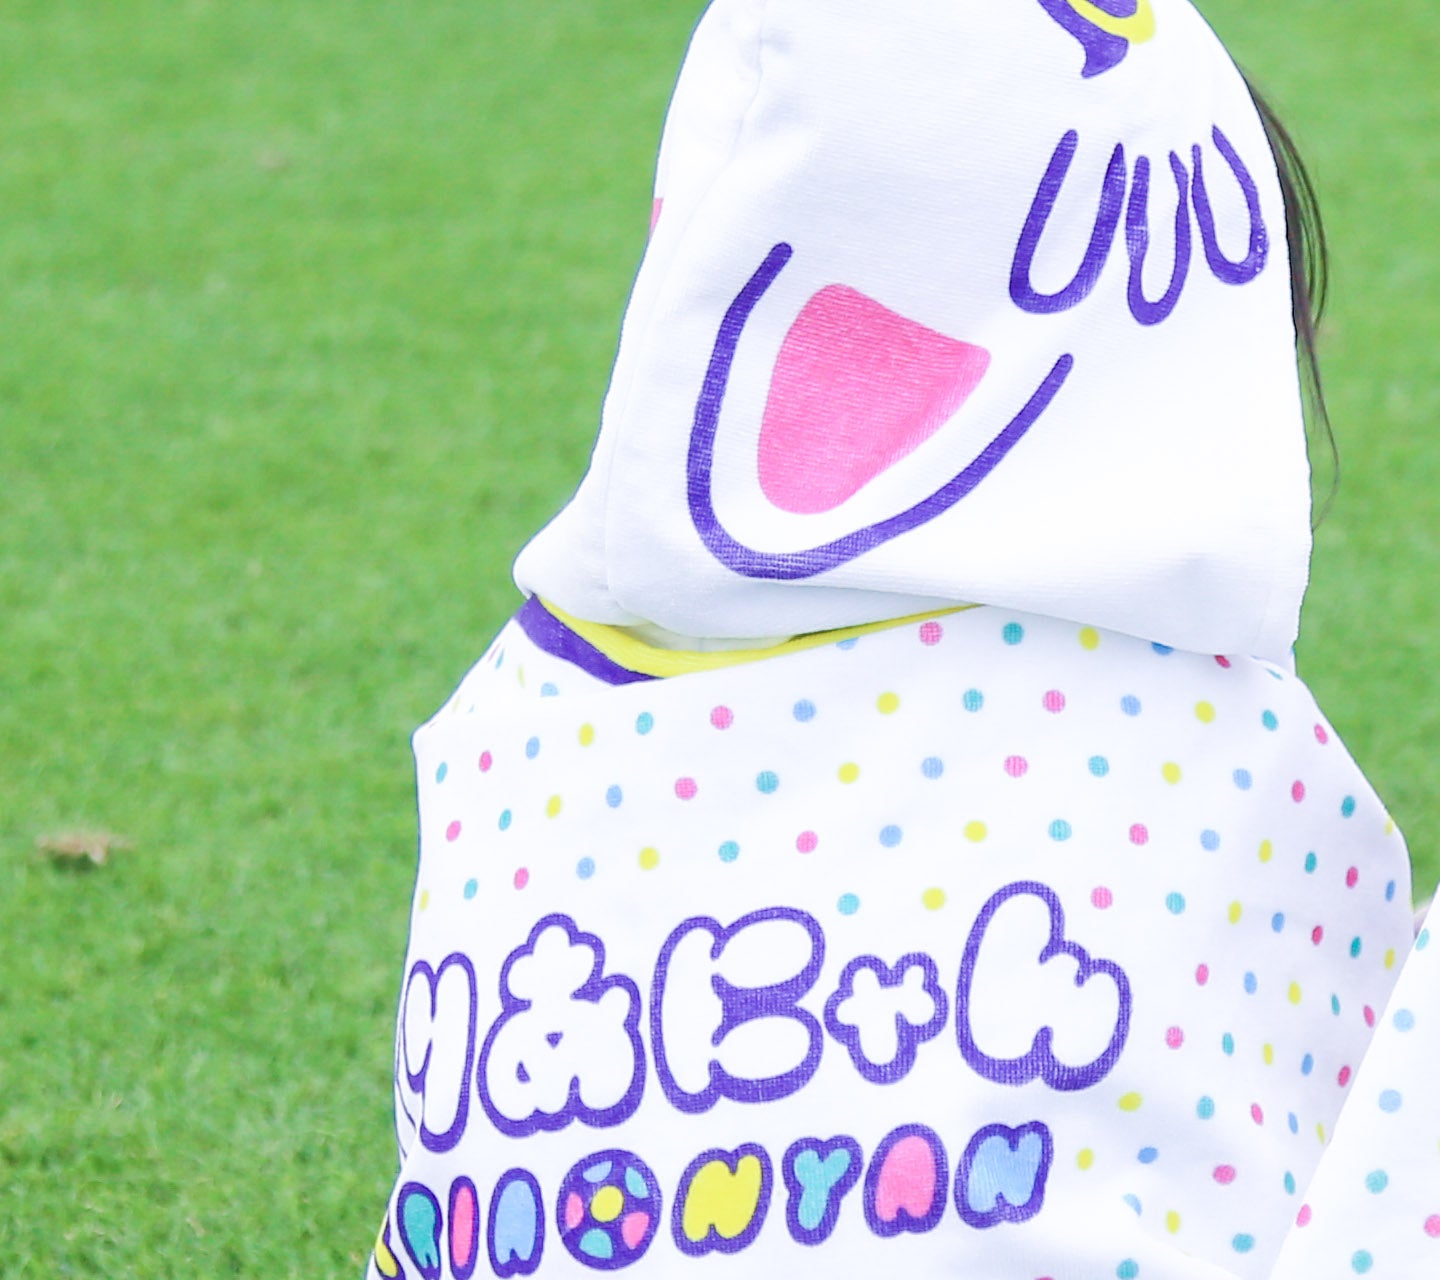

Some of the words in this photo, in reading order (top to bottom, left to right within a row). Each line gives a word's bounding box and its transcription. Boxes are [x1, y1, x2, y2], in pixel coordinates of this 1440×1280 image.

[396, 881, 1132, 1152] りあにゃん
